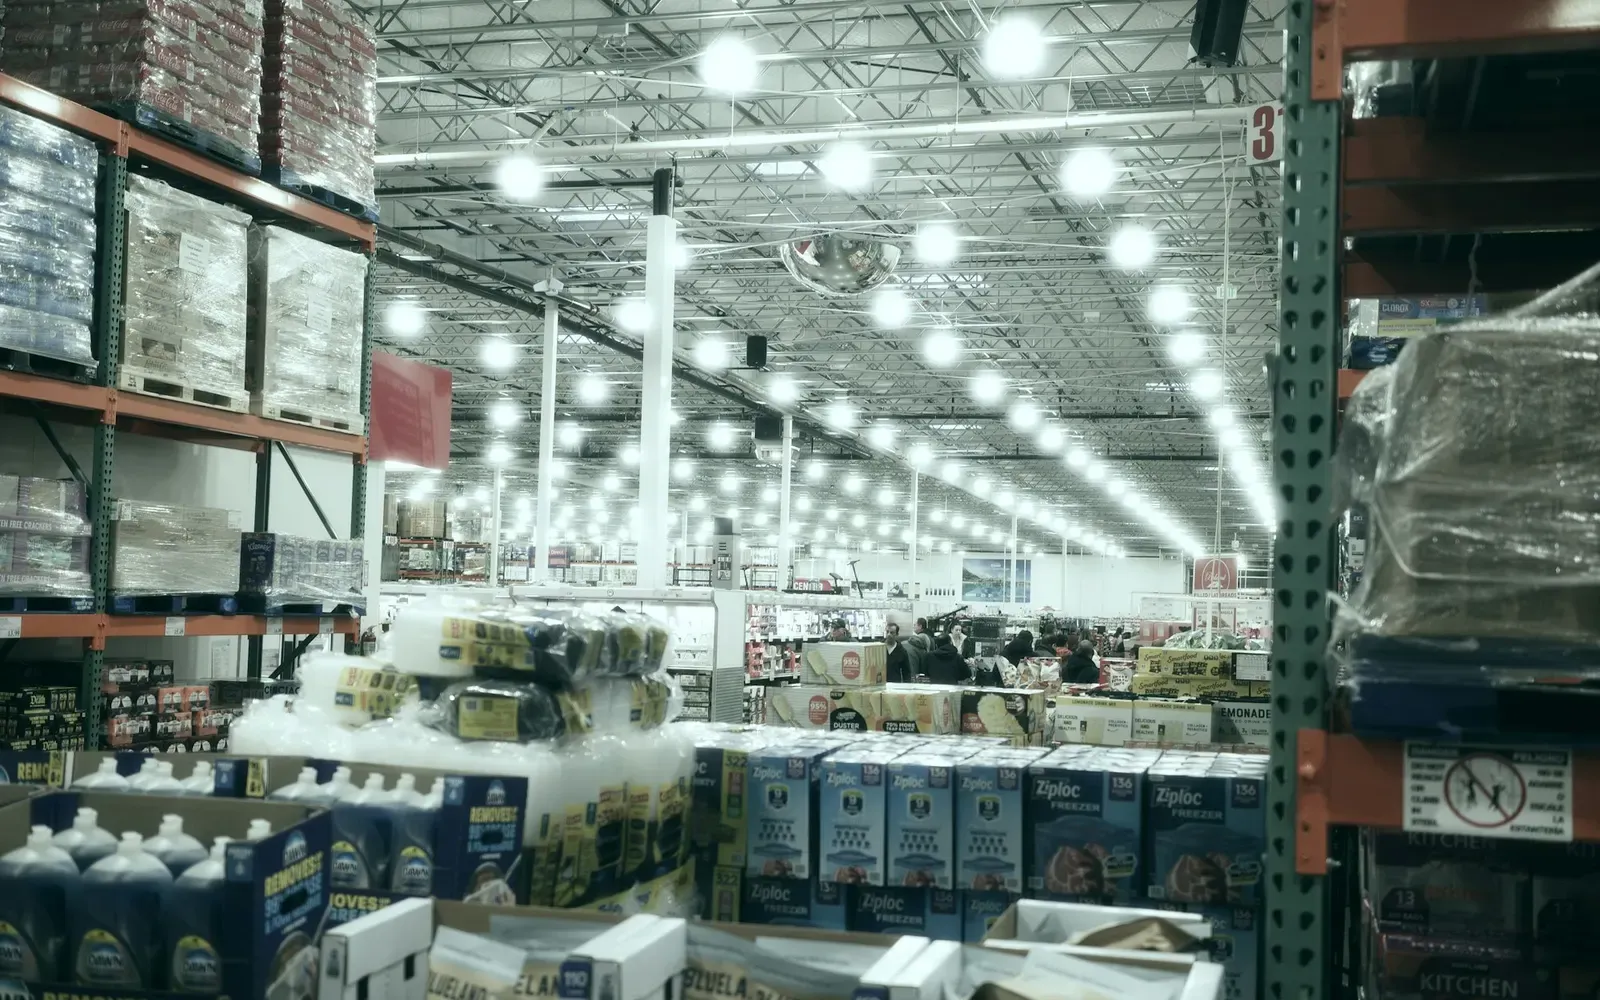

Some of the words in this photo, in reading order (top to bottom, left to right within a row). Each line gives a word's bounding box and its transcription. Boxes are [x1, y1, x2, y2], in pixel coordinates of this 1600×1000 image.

[1382, 303, 1409, 313] CLOROX
[9, 520, 23, 528] FREE
[24, 521, 52, 531] CRACKERS
[247, 542, 272, 552] Kleenex
[843, 658, 859, 666] 95%
[1167, 652, 1198, 663] Smartfood
[1138, 679, 1169, 690] Smartfood
[1196, 681, 1228, 692] Smartfood
[810, 702, 827, 710] 95%
[726, 755, 748, 767] 322
[787, 758, 804, 769] 136
[753, 766, 783, 781] Ziploc
[862, 764, 880, 776] 136
[928, 766, 947, 778] 136
[999, 769, 1017, 779] 136
[827, 771, 857, 787] Ziploc
[894, 775, 925, 790] Ziploc
[961, 778, 993, 791] Ziploc
[1112, 777, 1133, 789] 136
[1035, 779, 1081, 800] Ziploc
[1235, 784, 1256, 796] 136
[1156, 787, 1203, 808] Ziploc
[1051, 801, 1101, 813] FREEZER
[1172, 808, 1223, 820] FREEZER
[333, 861, 358, 872] DAWN
[403, 867, 429, 878] DAWN
[716, 873, 738, 886] 322
[751, 882, 791, 903] Ziploc
[1395, 890, 1416, 906] 13
[862, 893, 905, 912] Ziploc
[764, 904, 808, 915] FREEZER
[876, 914, 923, 925] FREEZER
[88, 953, 124, 966] DAWN
[184, 962, 216, 973] DAWN
[1420, 972, 1518, 998] KITCHEN
